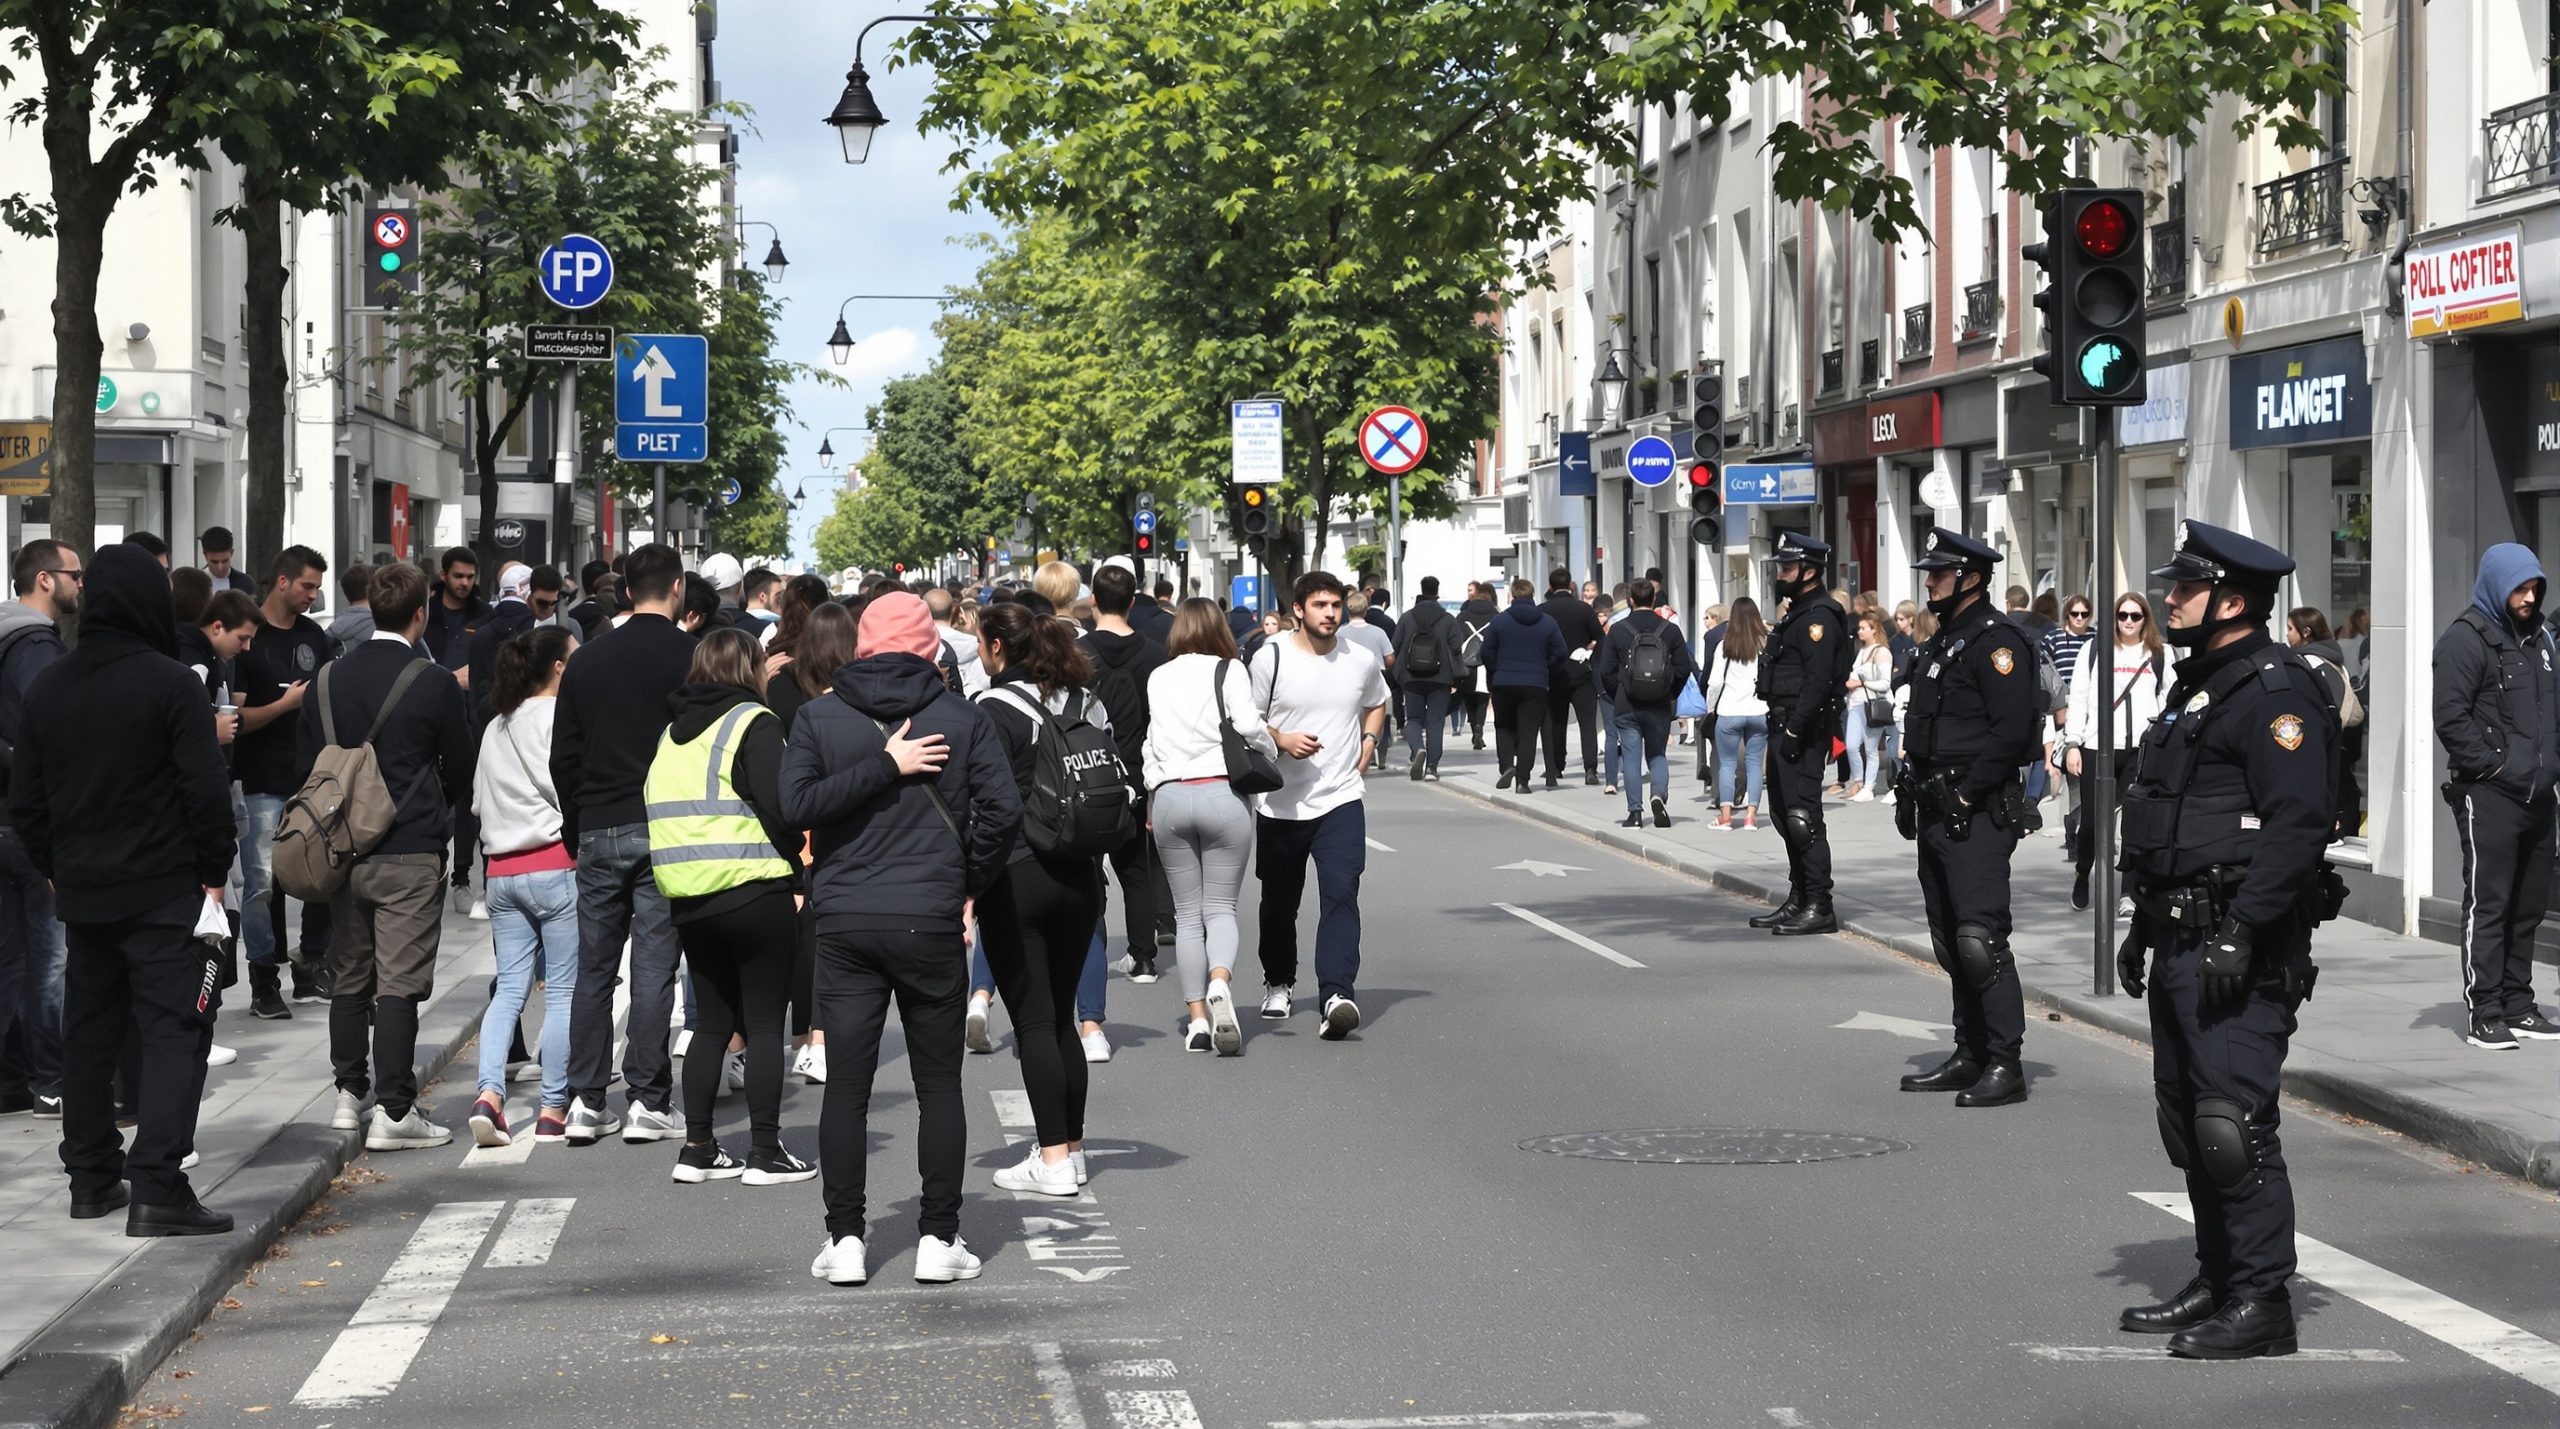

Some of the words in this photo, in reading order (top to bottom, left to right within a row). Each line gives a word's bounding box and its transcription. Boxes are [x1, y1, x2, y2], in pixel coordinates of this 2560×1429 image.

[553, 251, 602, 292] FP
[2409, 256, 2446, 301] POLL
[2450, 241, 2516, 293] COFTIER
[638, 433, 681, 452] PLET
[1063, 749, 1110, 775] POLICE
